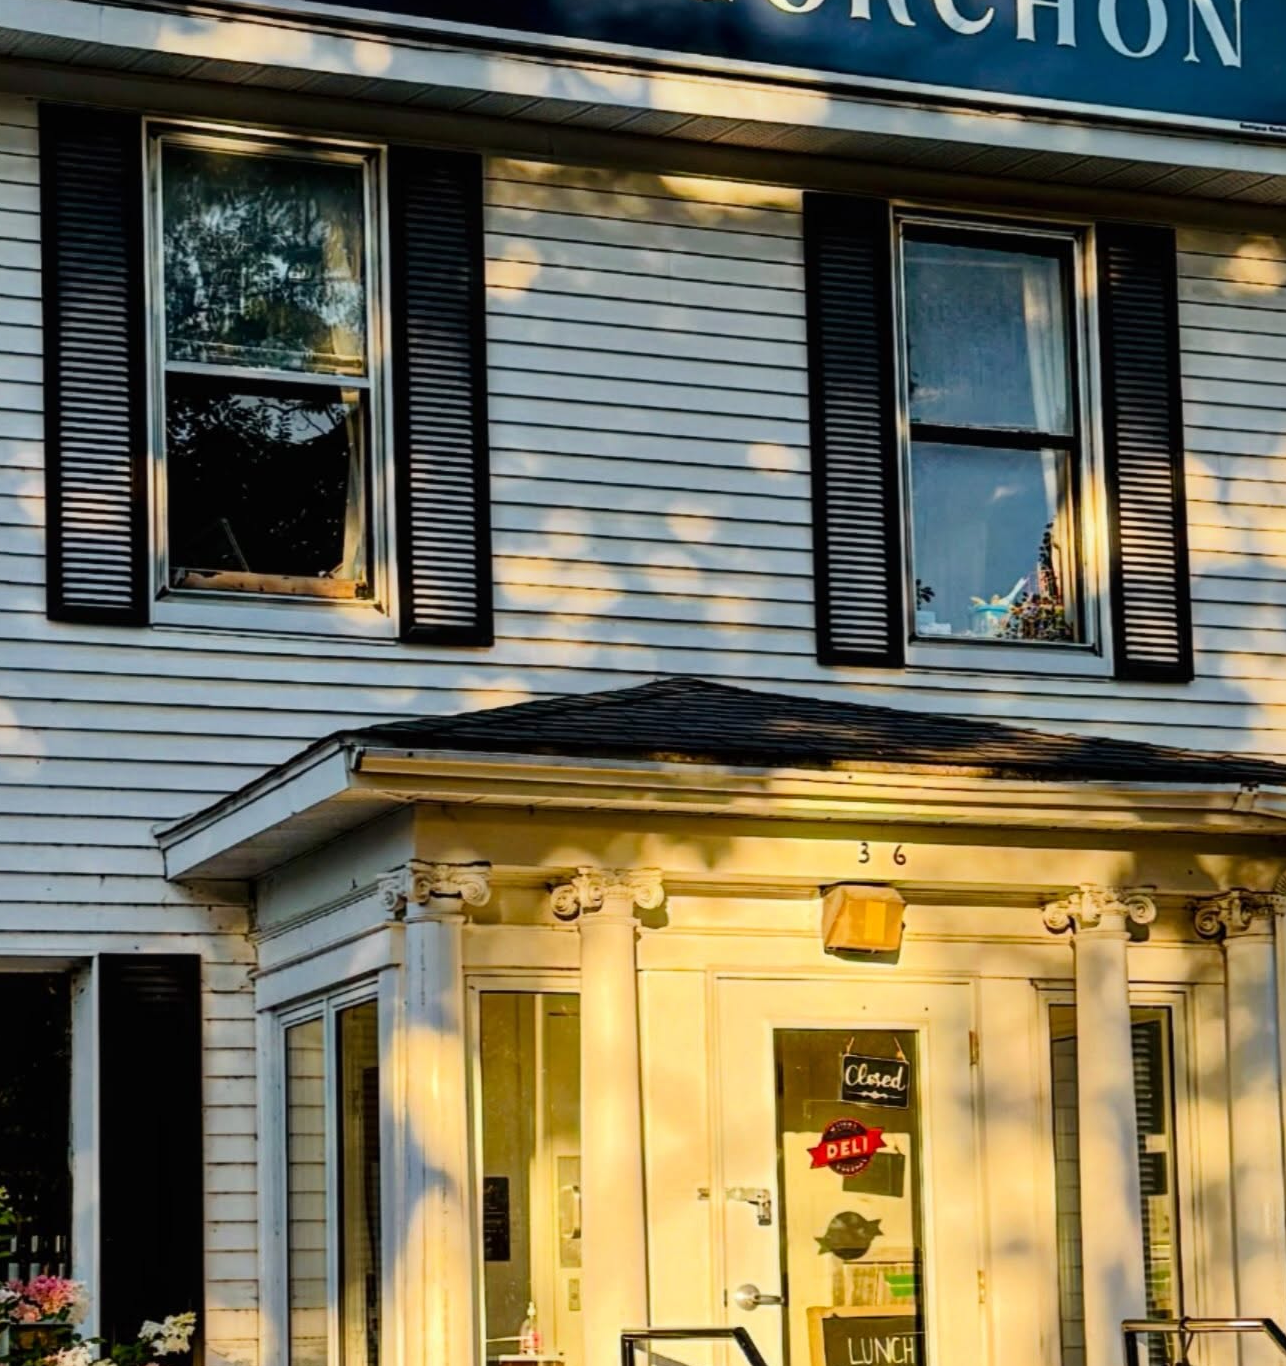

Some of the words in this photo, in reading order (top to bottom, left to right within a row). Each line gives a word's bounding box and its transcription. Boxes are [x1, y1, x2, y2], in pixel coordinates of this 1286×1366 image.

[845, 1063, 906, 1092] Closed
[826, 1135, 868, 1160] DELI
[847, 1337, 915, 1365] LUNCH
